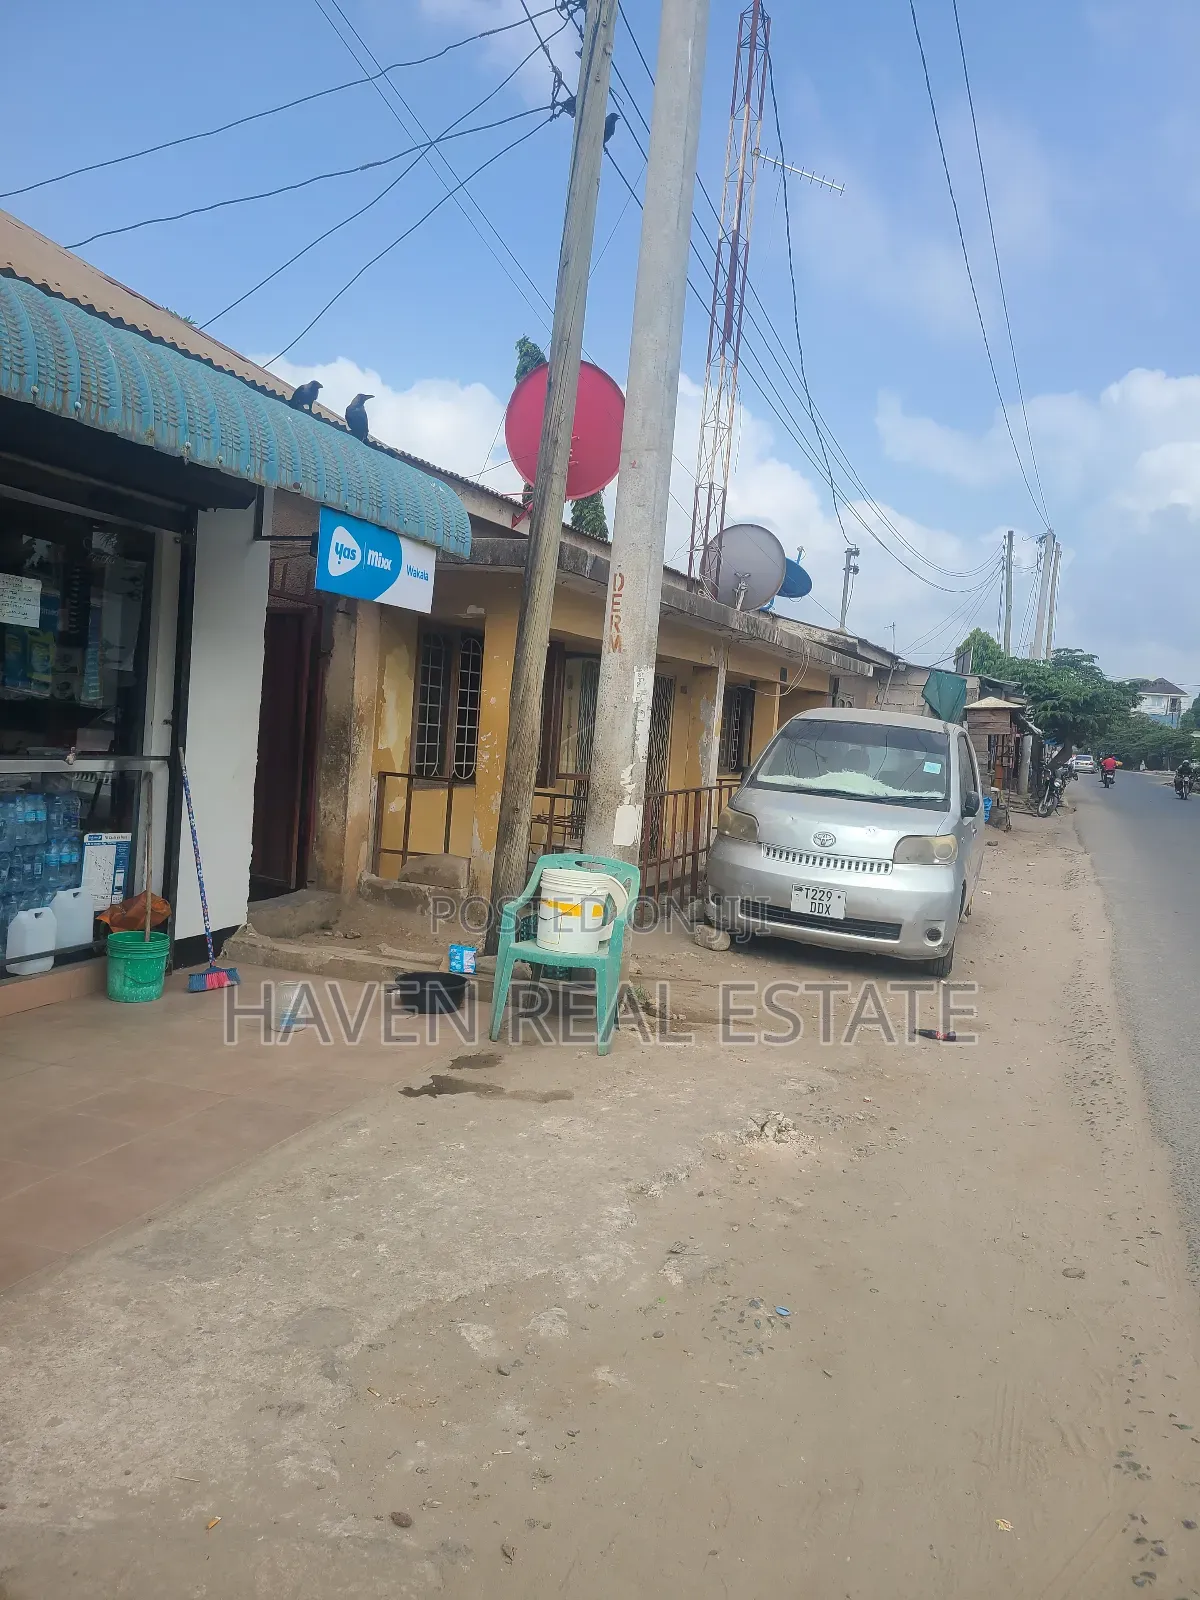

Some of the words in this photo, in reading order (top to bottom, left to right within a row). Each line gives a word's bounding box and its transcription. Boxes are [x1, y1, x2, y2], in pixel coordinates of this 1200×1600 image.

[406, 564, 429, 582] Wakala
[608, 572, 624, 654] DERM
[805, 887, 833, 902] T229
[810, 901, 831, 916] DDX
